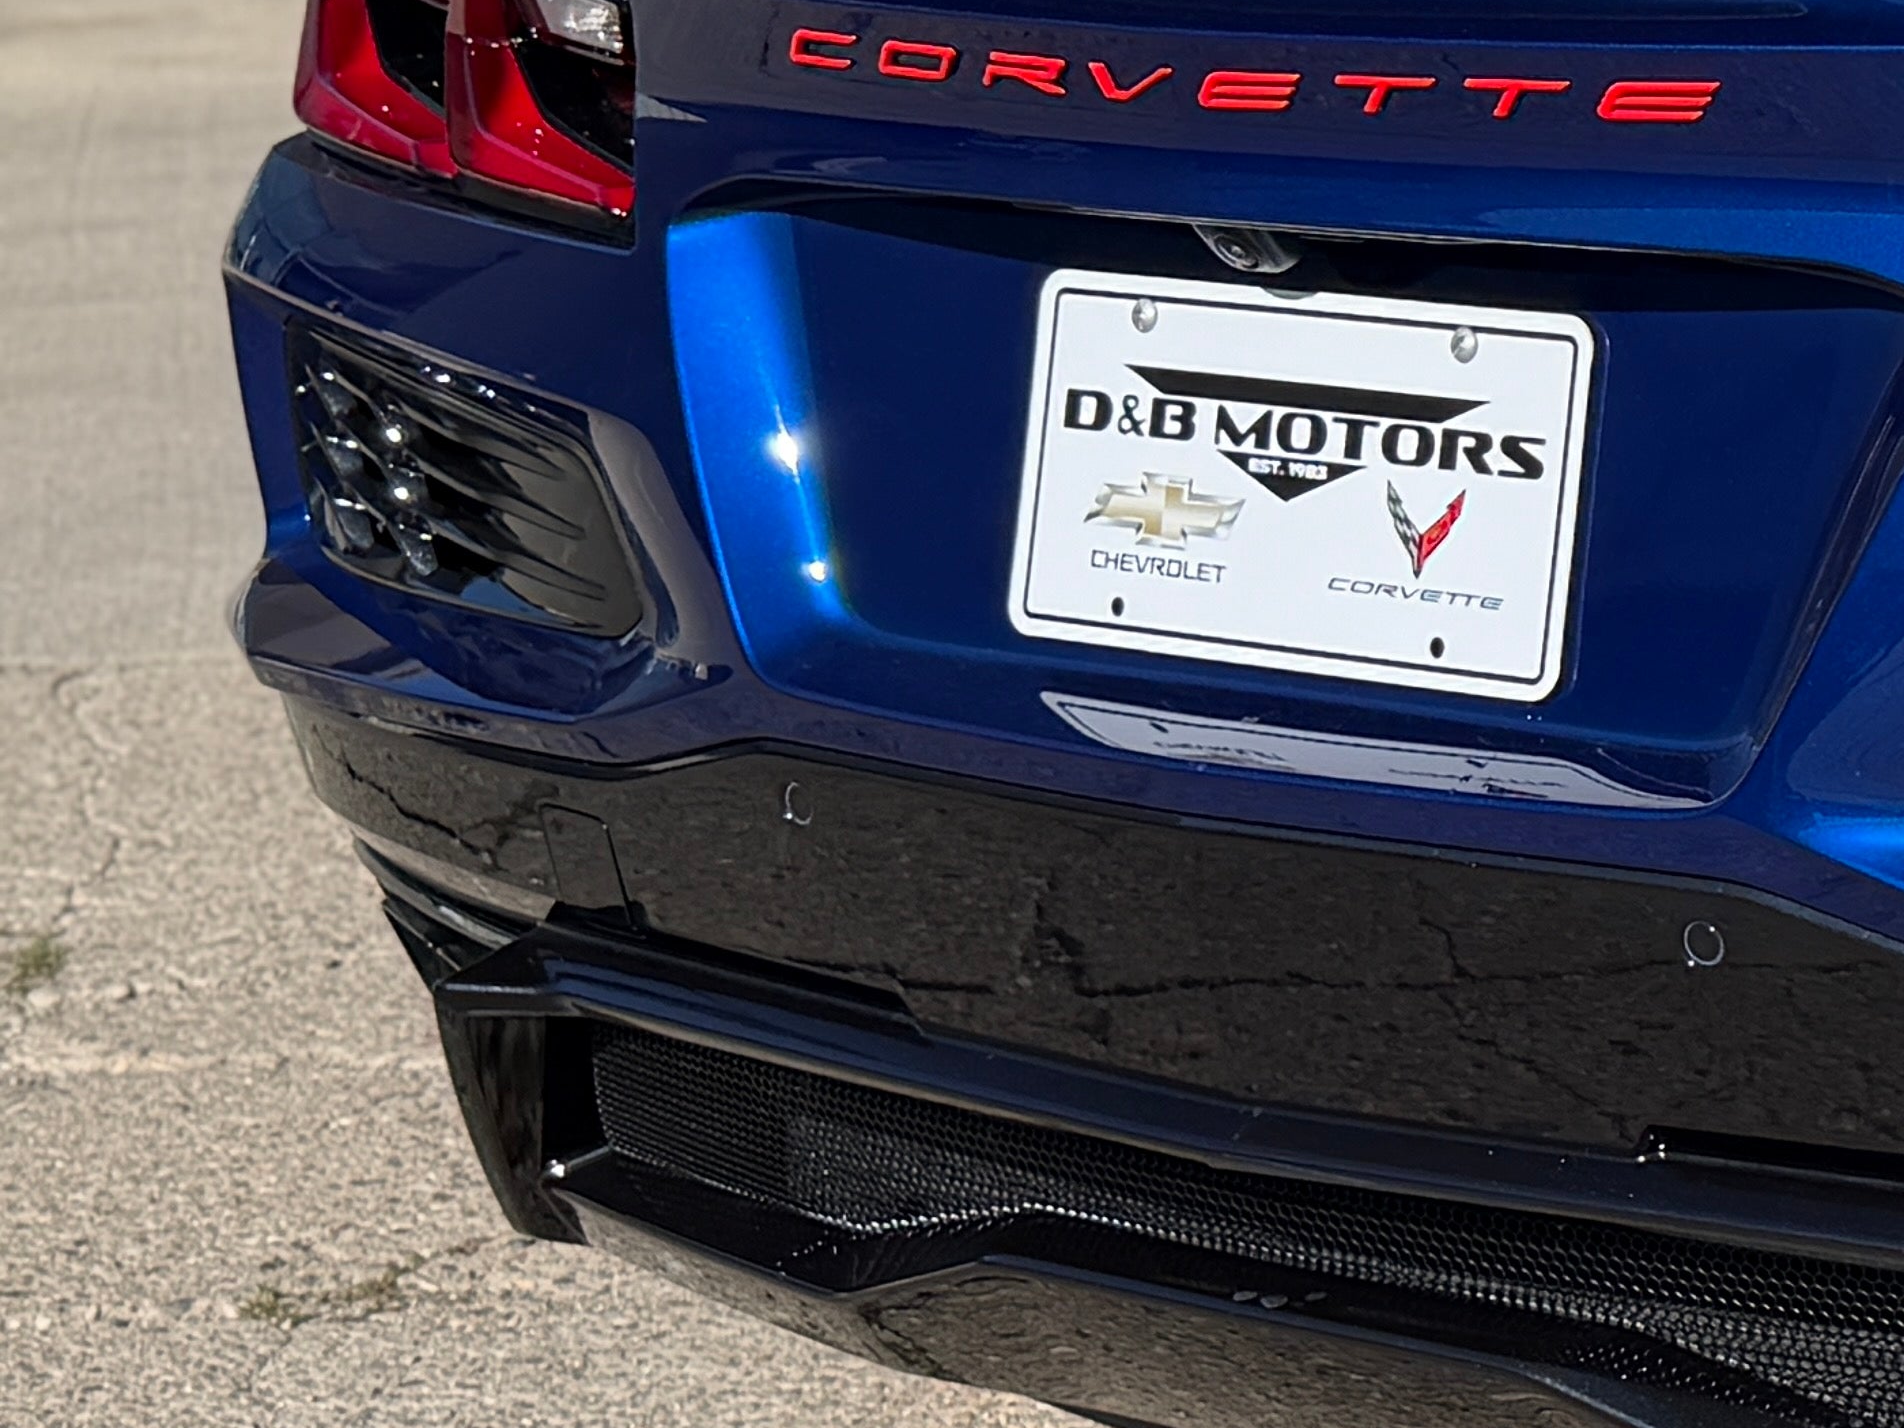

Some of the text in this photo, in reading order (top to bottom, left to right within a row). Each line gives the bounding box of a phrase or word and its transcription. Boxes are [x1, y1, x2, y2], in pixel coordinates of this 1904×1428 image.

[788, 26, 1723, 124] CORVETTE
[1063, 388, 1547, 481] D&B MOTORS
[1248, 457, 1285, 476] EST.
[1091, 548, 1227, 585] CHEVROLET
[1328, 576, 1504, 612] CORVETTE
